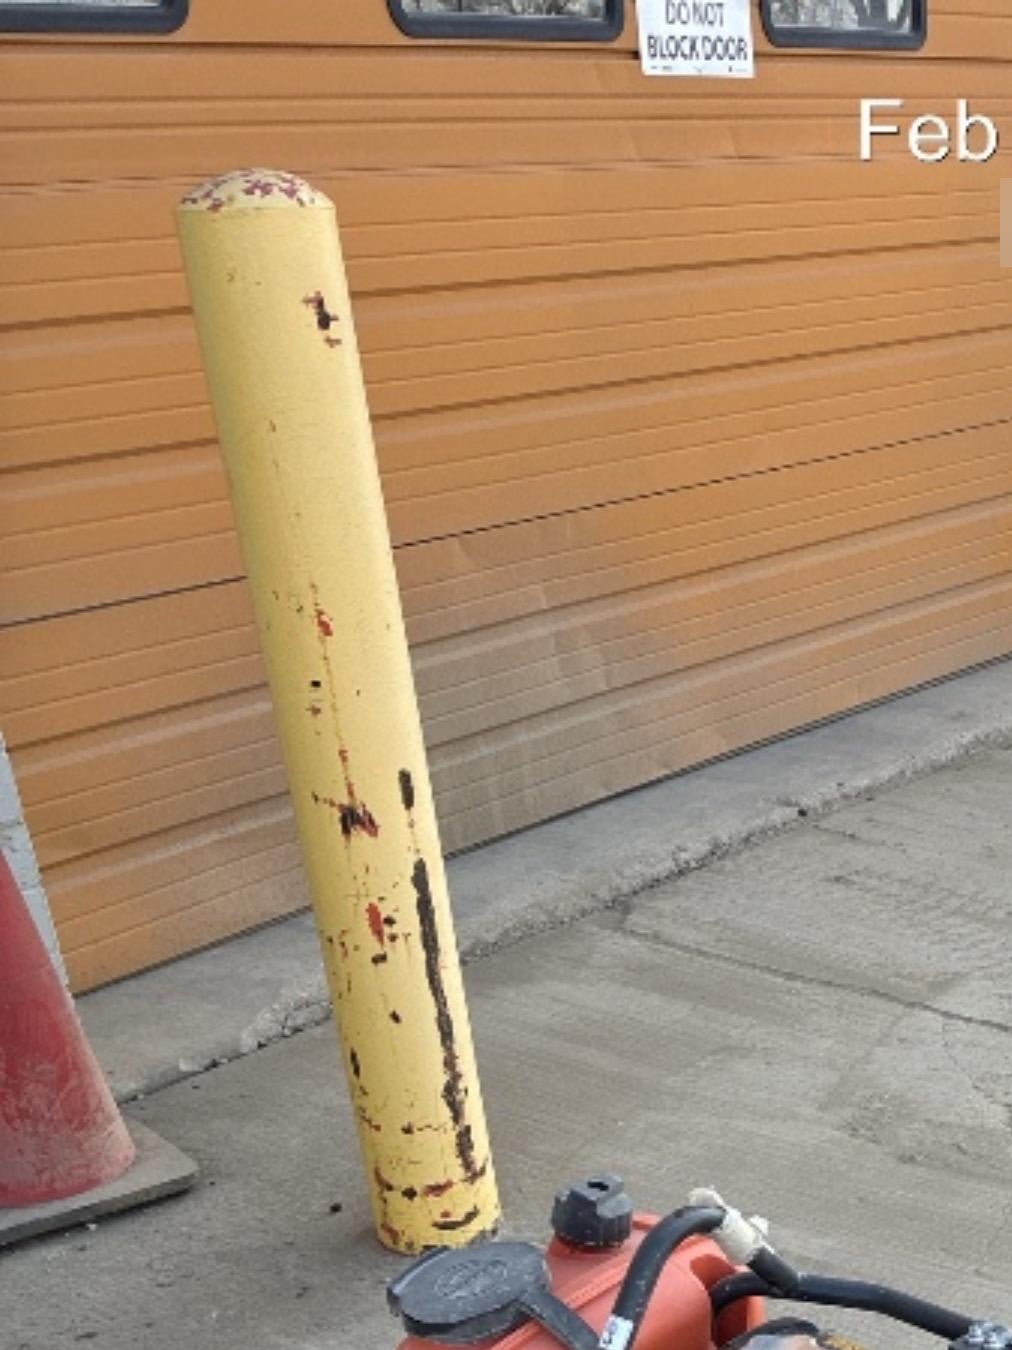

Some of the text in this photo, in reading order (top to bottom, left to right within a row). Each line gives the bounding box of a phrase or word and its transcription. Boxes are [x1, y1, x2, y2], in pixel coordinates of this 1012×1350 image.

[665, 0, 725, 27] DO NOT
[647, 34, 748, 62] BLOCK DOOR
